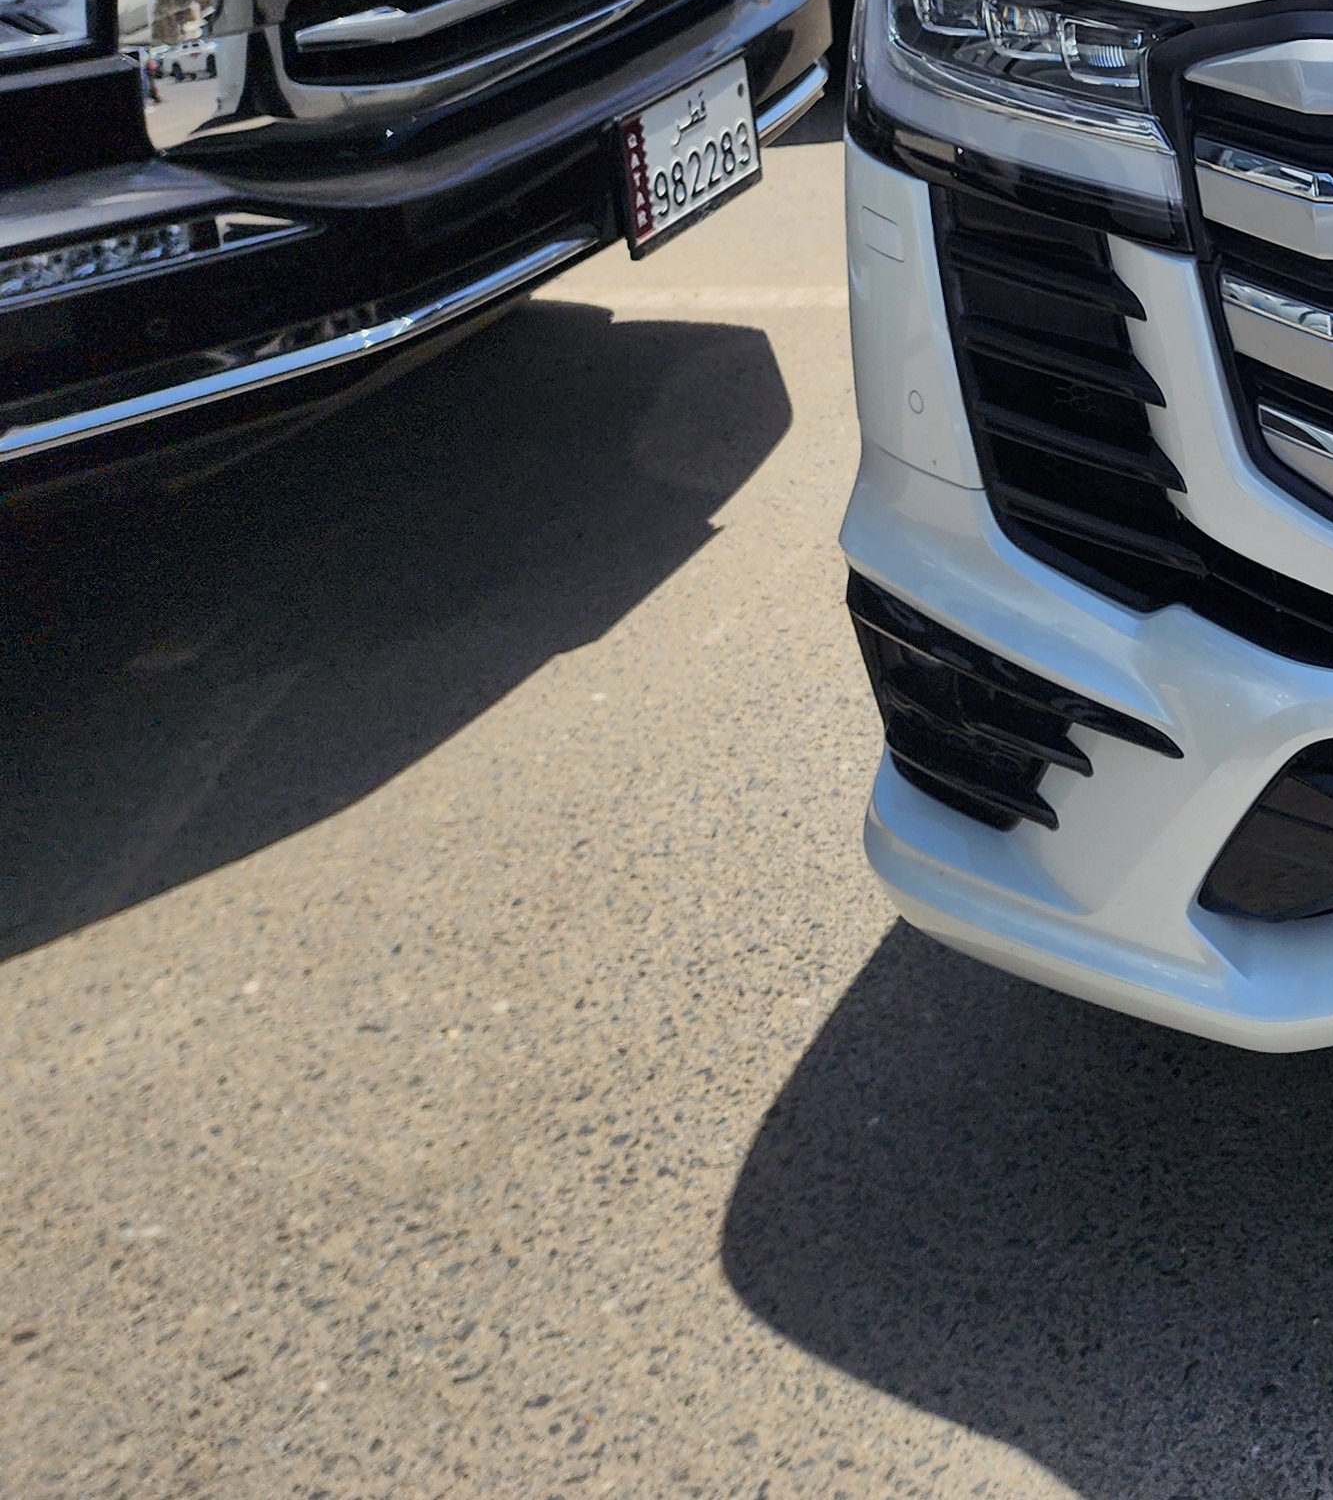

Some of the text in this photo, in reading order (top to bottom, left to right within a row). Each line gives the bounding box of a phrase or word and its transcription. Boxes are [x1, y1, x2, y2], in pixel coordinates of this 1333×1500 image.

[670, 90, 707, 147] قطر
[627, 132, 649, 229] QATAR
[653, 120, 751, 217] 982283
